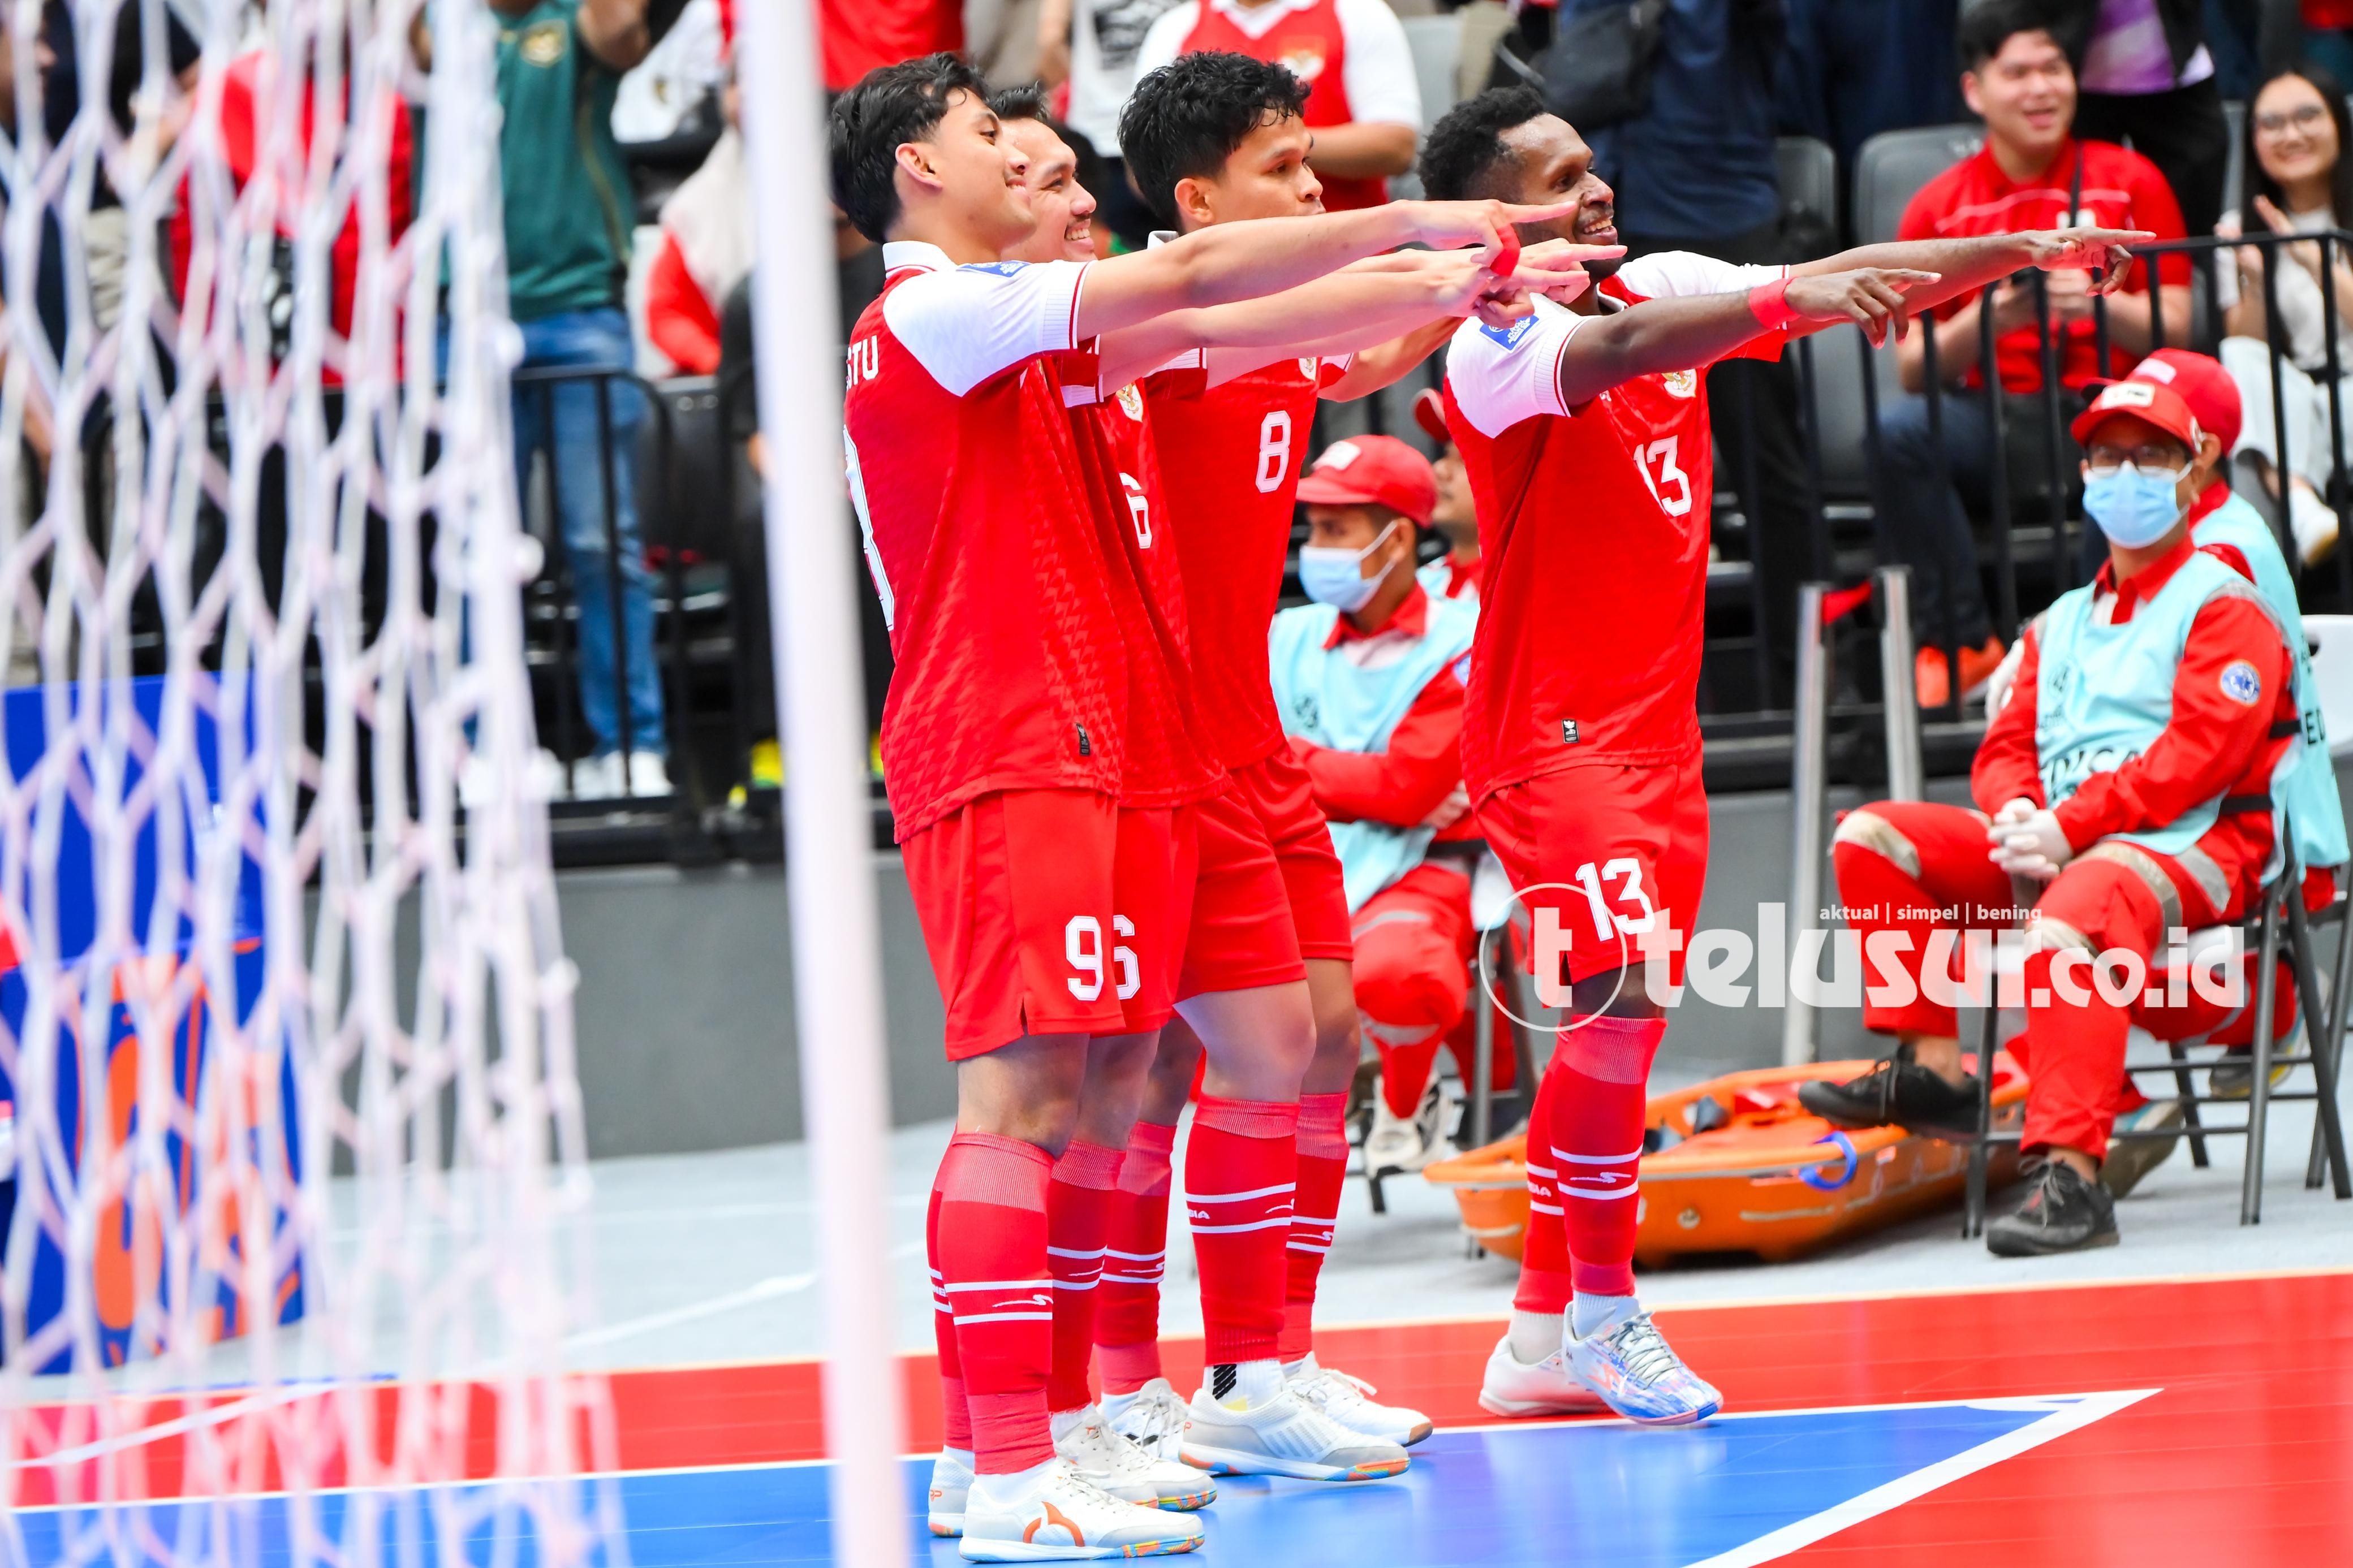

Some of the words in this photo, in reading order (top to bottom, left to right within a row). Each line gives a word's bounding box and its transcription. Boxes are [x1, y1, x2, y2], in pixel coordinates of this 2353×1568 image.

[1255, 410, 1291, 493] 8
[1634, 435, 1692, 517] 13
[1575, 858, 1656, 941] 13
